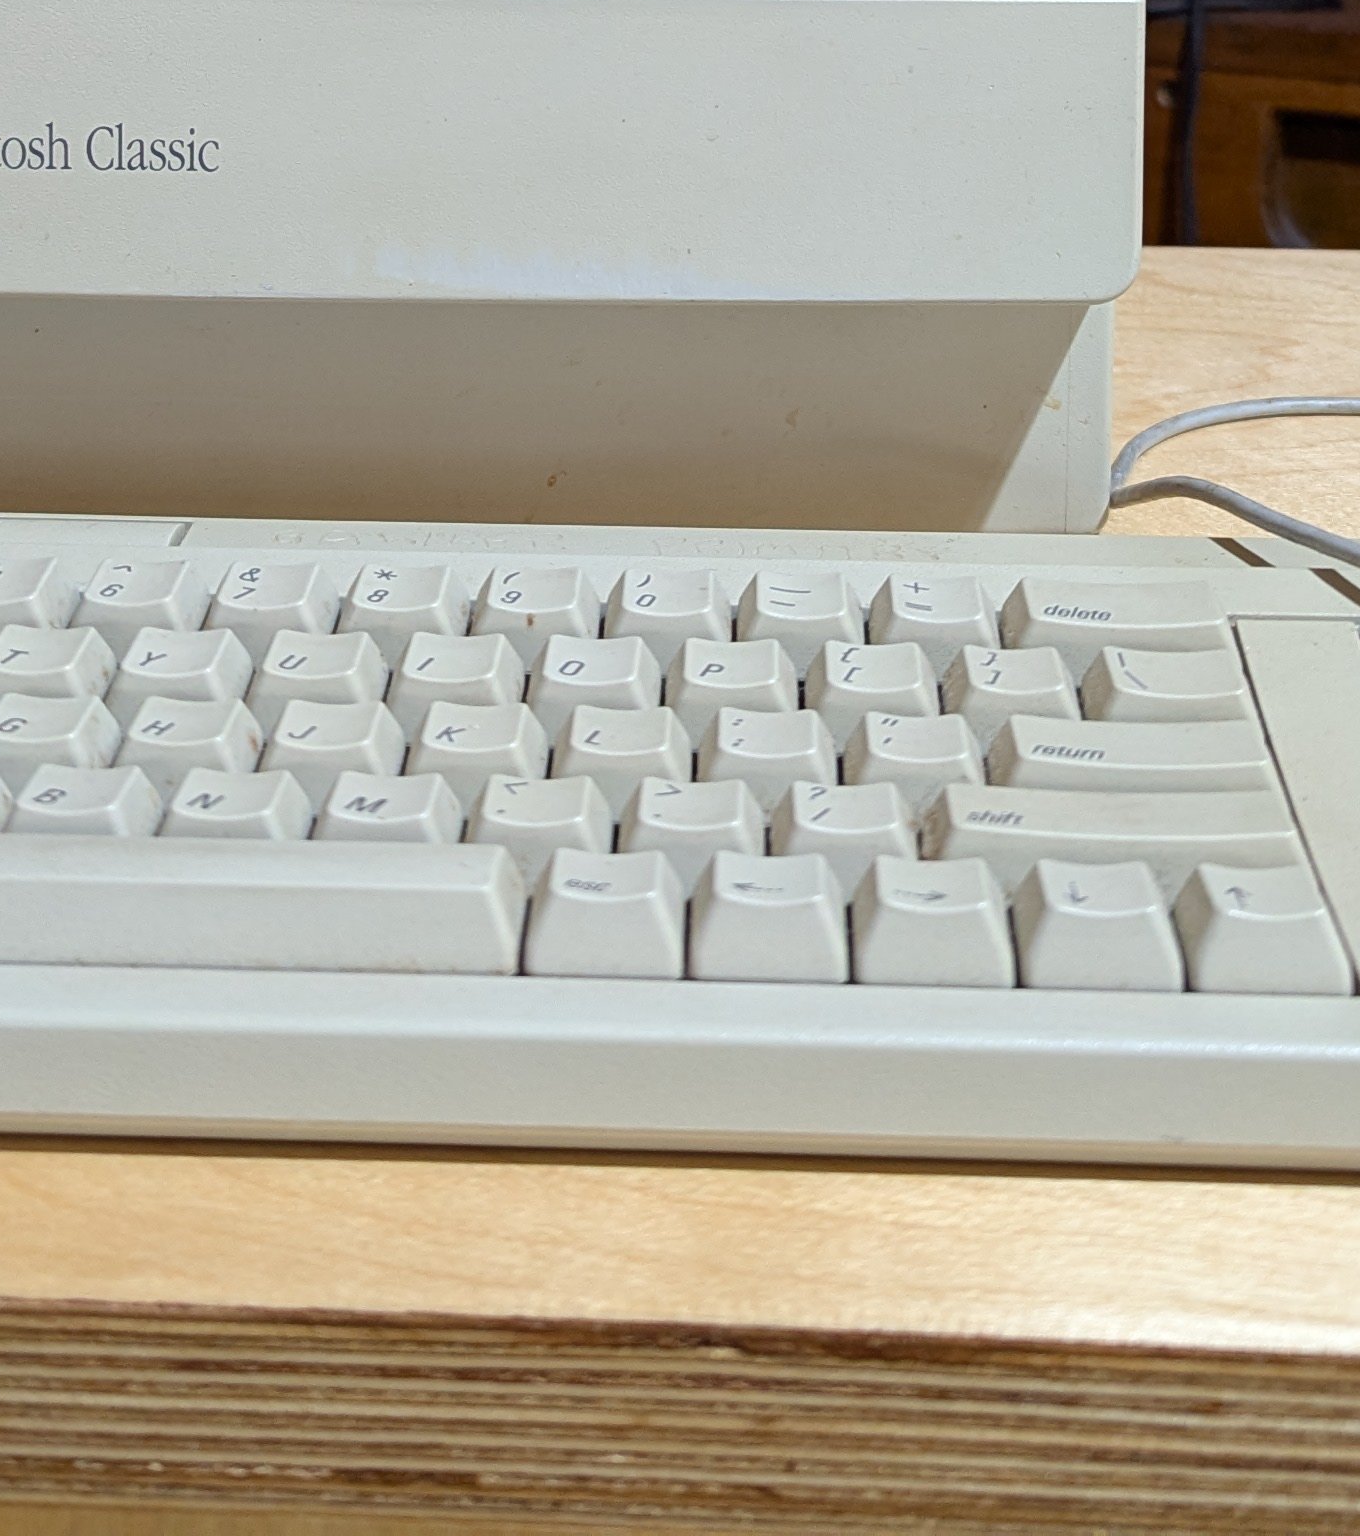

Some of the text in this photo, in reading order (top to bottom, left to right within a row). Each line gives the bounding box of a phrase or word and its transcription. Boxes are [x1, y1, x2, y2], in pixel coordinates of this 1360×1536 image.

[85, 123, 221, 173] Classic
[99, 583, 125, 598] 6
[232, 586, 257, 600] 7
[366, 589, 390, 603] 8
[500, 590, 523, 604] 9
[1043, 604, 1112, 622] delete
[1, 648, 30, 665] T
[139, 651, 168, 667] Y
[278, 654, 308, 671] U
[558, 660, 586, 677] O
[699, 663, 725, 677] P
[141, 720, 176, 737] H
[287, 725, 318, 740] J
[435, 726, 467, 743] K
[583, 730, 601, 746] L
[1031, 744, 1106, 761] return
[32, 788, 68, 805] B
[186, 793, 225, 810] N
[344, 796, 388, 814] M
[966, 810, 1024, 825] shift
